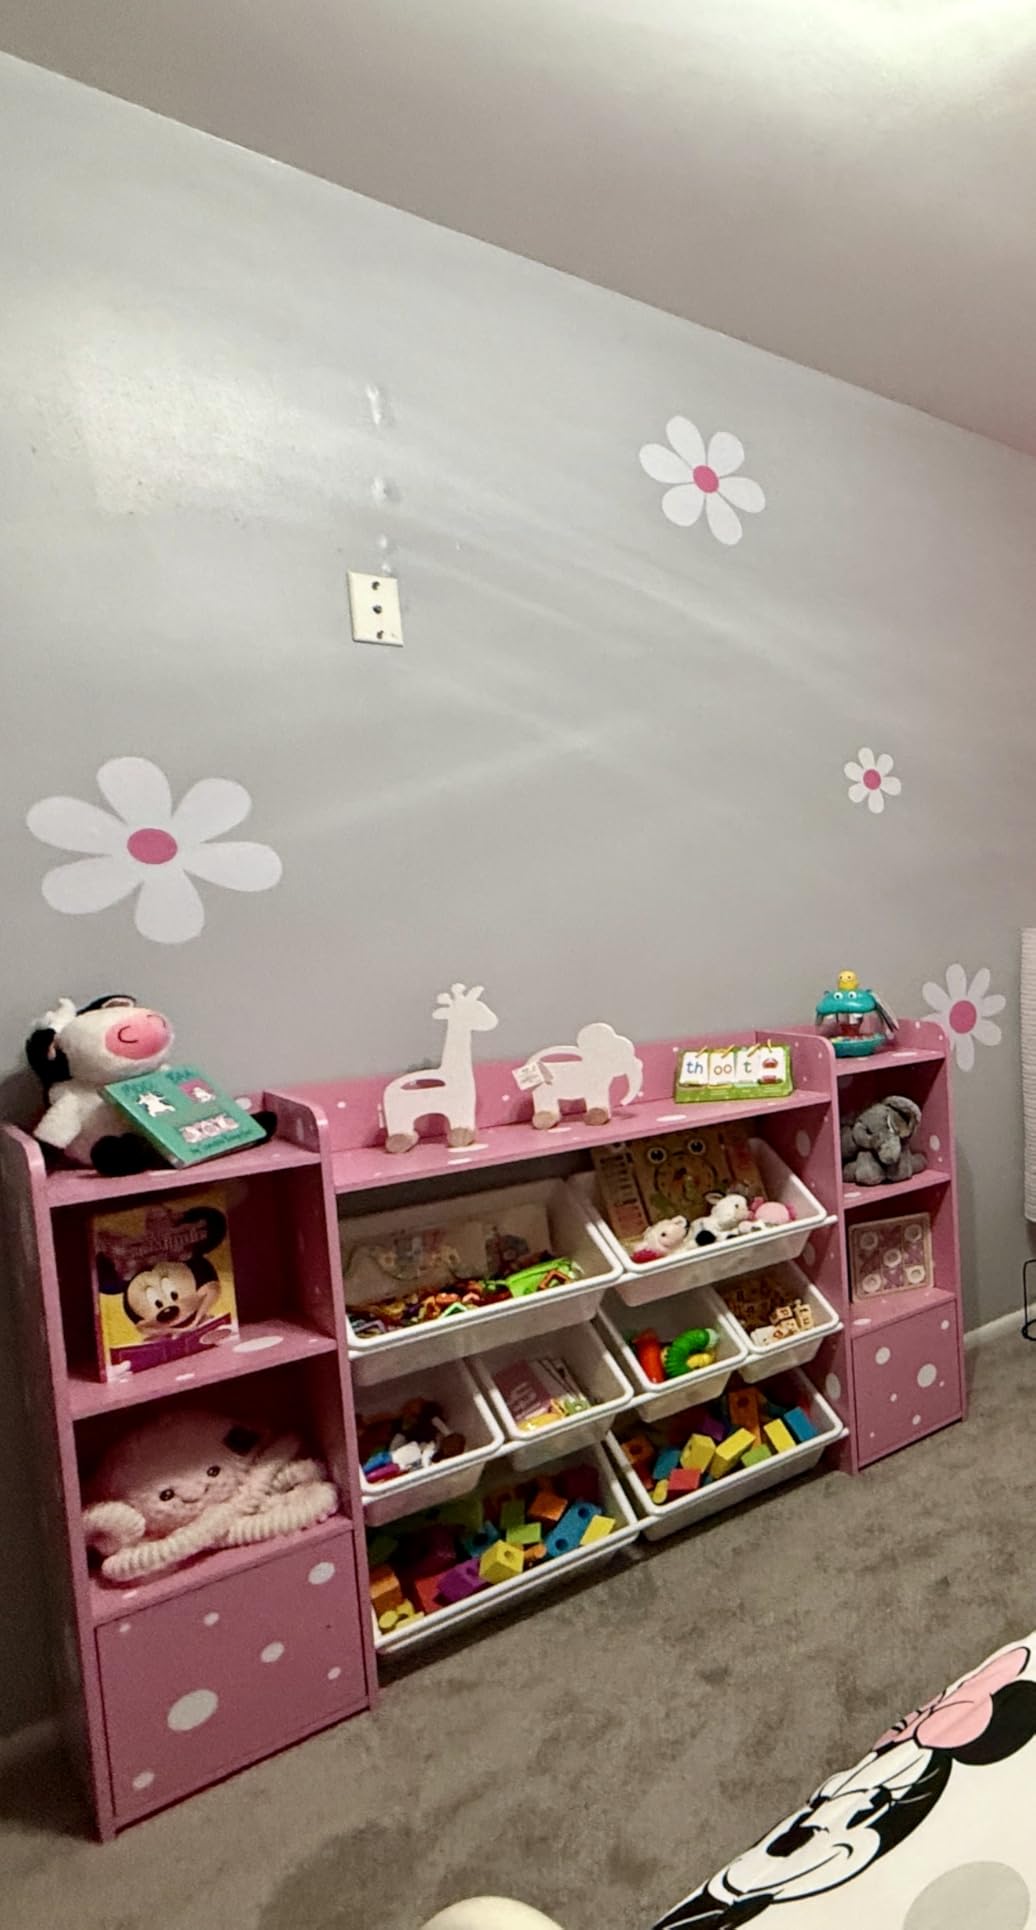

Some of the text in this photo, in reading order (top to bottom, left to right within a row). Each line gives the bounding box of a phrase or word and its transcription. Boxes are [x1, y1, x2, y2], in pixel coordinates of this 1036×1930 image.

[686, 1061, 752, 1076] th oo t
